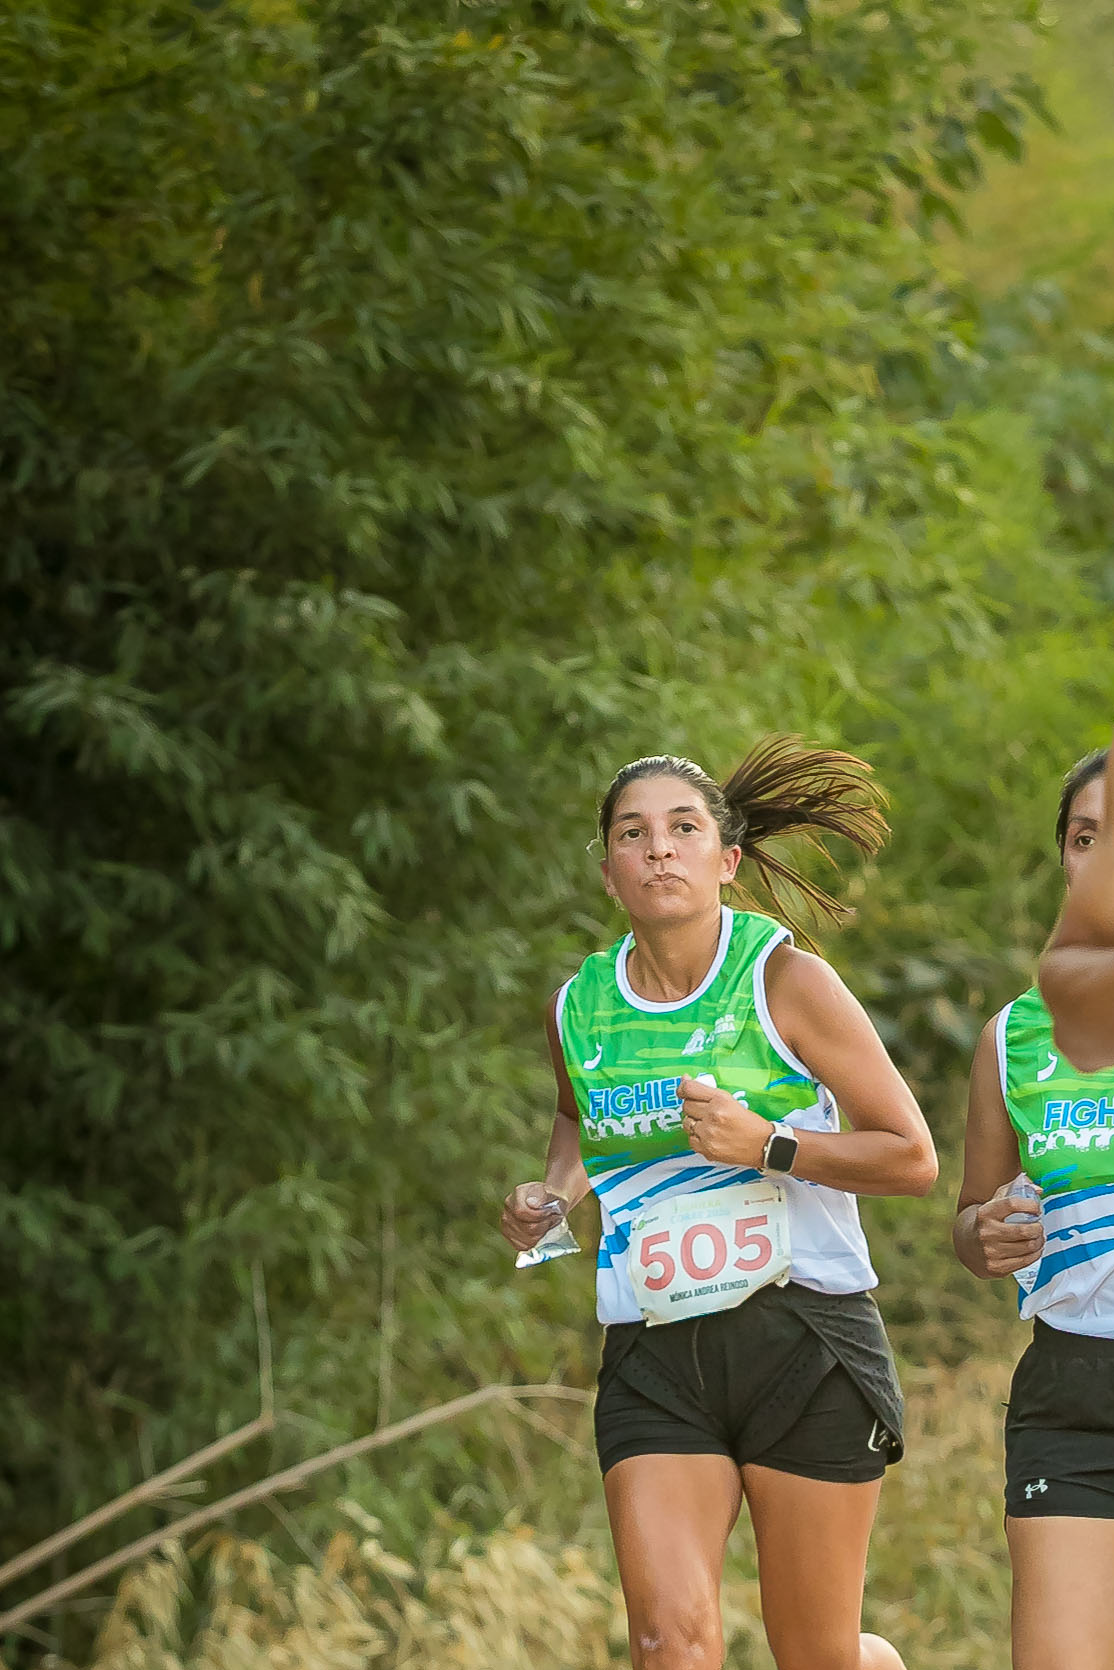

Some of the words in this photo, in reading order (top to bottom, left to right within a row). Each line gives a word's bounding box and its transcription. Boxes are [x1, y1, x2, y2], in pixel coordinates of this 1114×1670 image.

[588, 1072, 718, 1119] FIGHIE
[639, 1214, 773, 1291] 505
[694, 1284, 719, 1297] ANDREA
[720, 1279, 749, 1291] REINOSO
